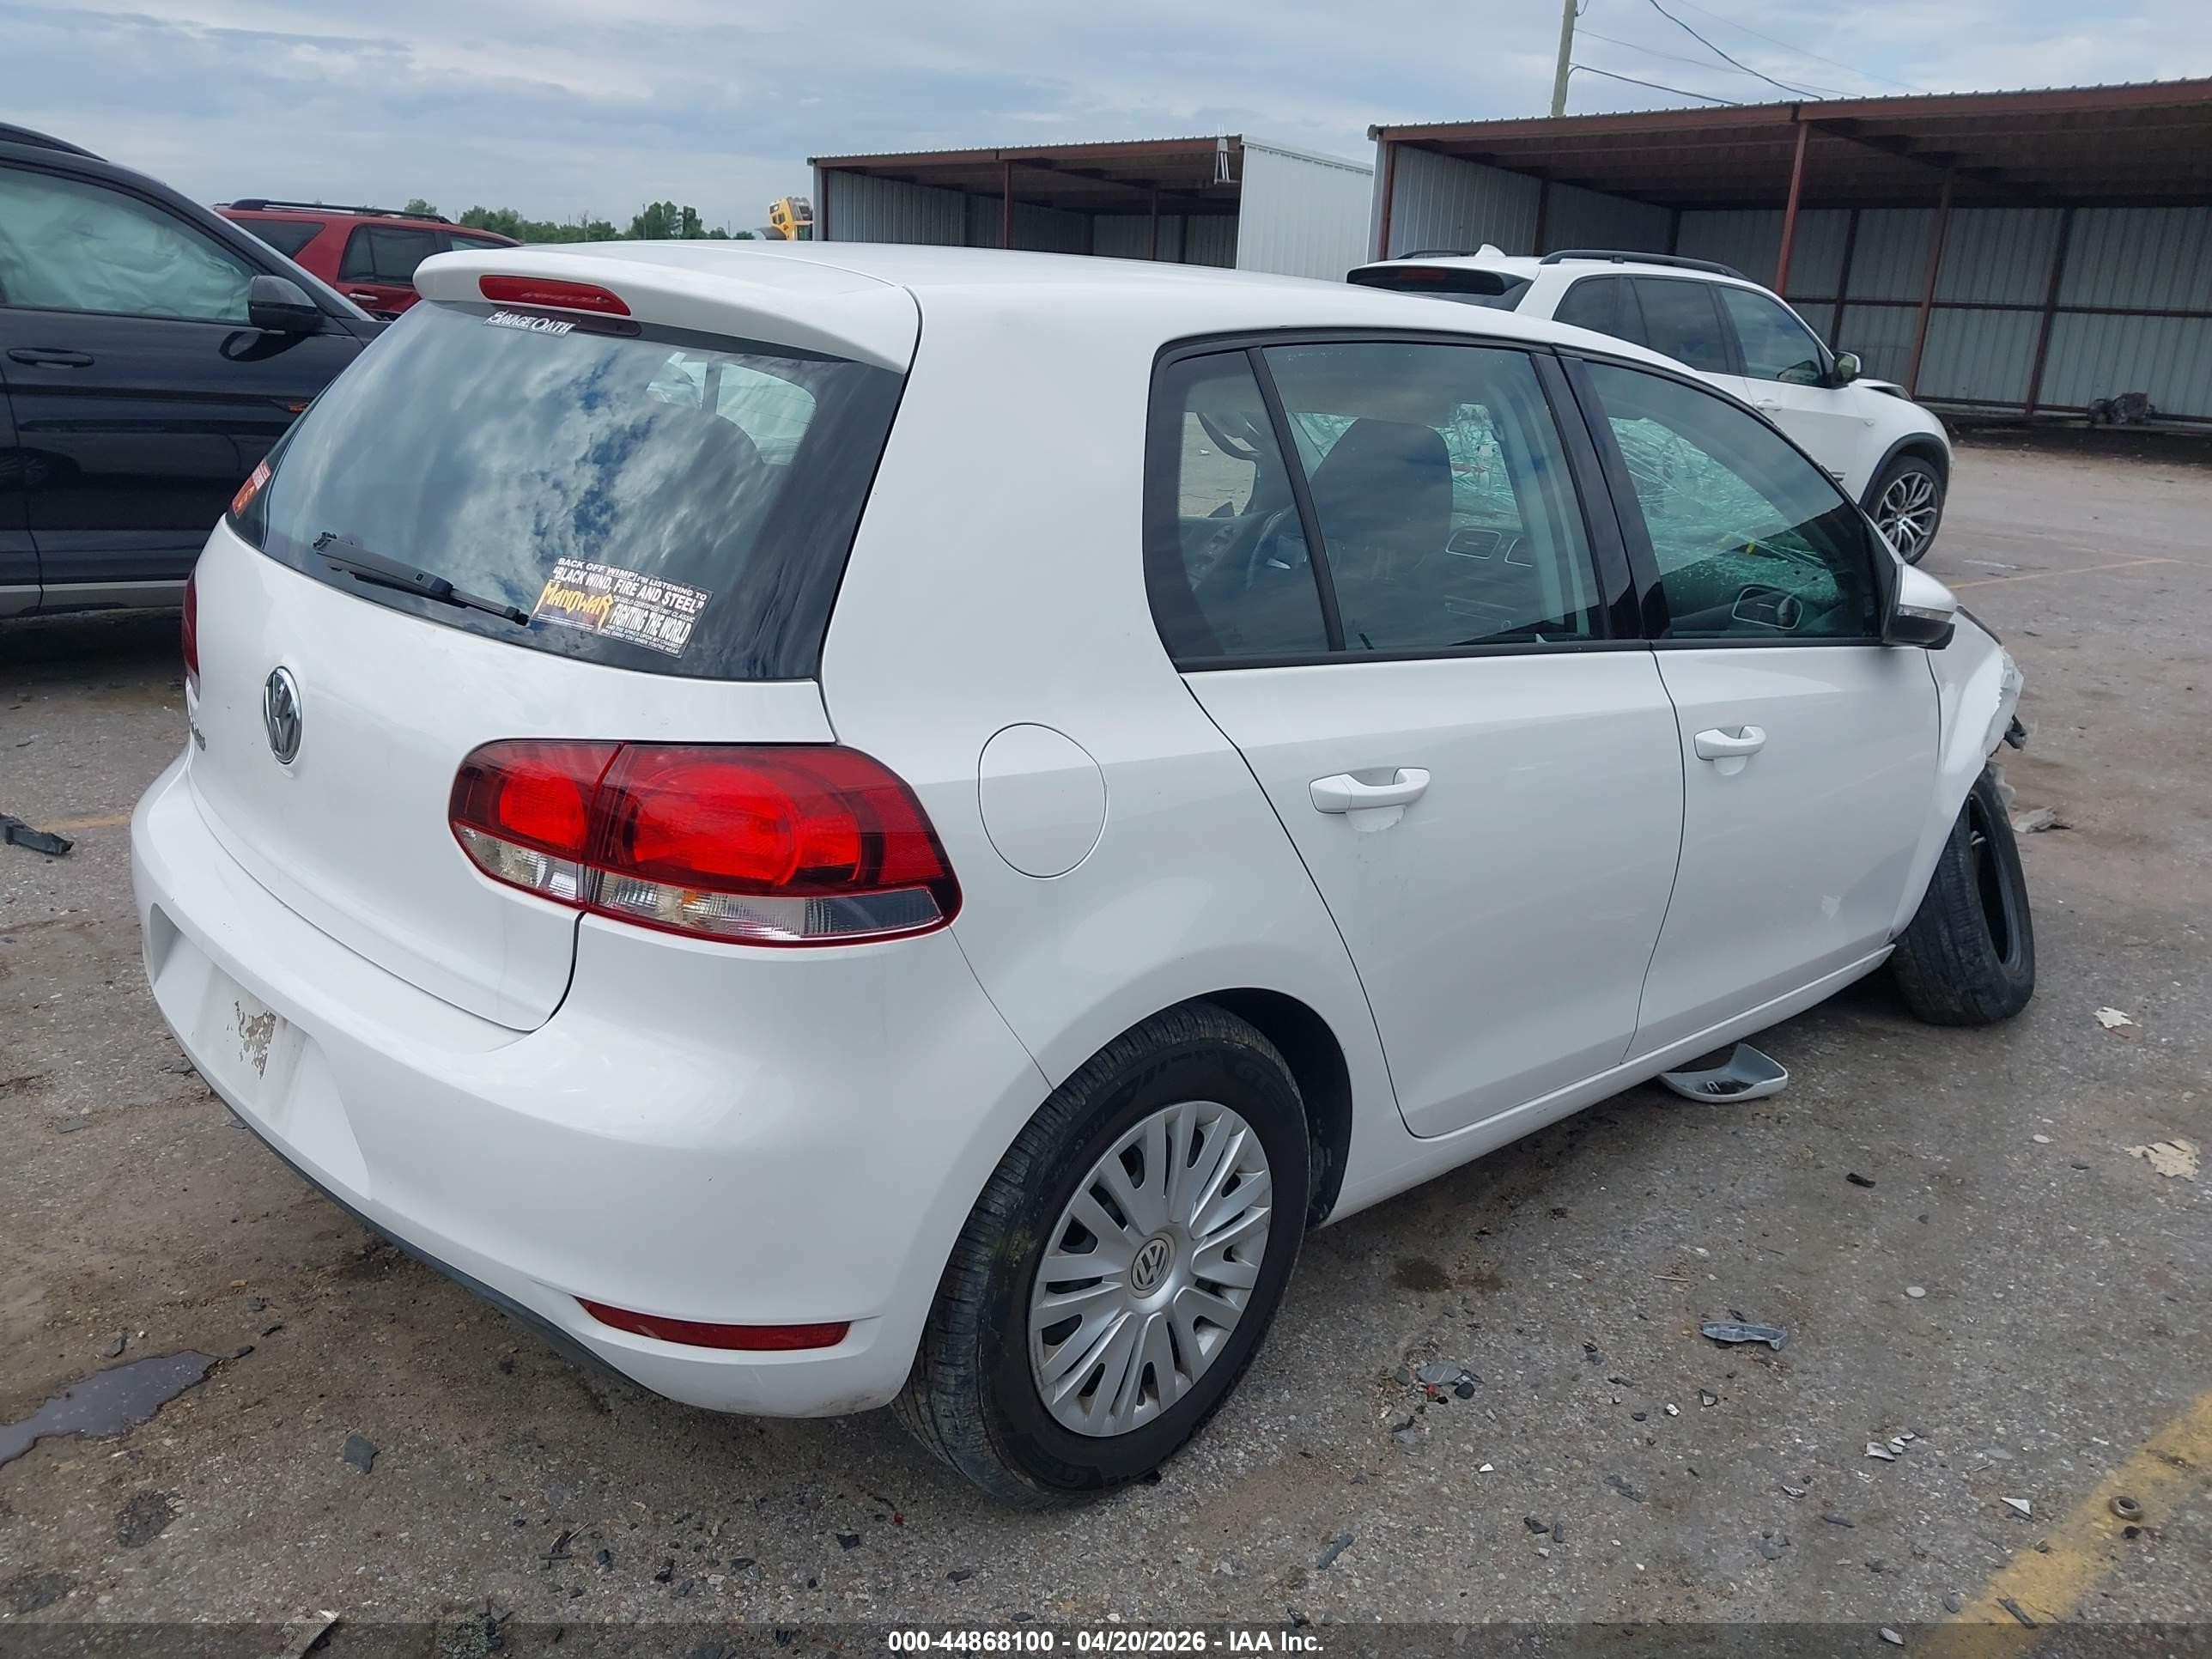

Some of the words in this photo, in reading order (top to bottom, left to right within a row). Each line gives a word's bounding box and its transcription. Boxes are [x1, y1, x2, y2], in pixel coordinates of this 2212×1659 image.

[483, 310, 538, 329] SAVAGE
[529, 318, 576, 334] OATH
[558, 557, 585, 568] BACK
[586, 563, 605, 572] OFF
[606, 567, 638, 581] WIMP!
[649, 579, 693, 596] LISTENING
[696, 592, 708, 600] TO
[585, 573, 612, 593] WIND,
[612, 579, 640, 597] FIRE
[636, 585, 662, 603] AND
[609, 603, 649, 631] FIGHTING
[644, 611, 665, 636] THE
[659, 617, 692, 644] WORLD
[672, 611, 696, 623] CLASSIC
